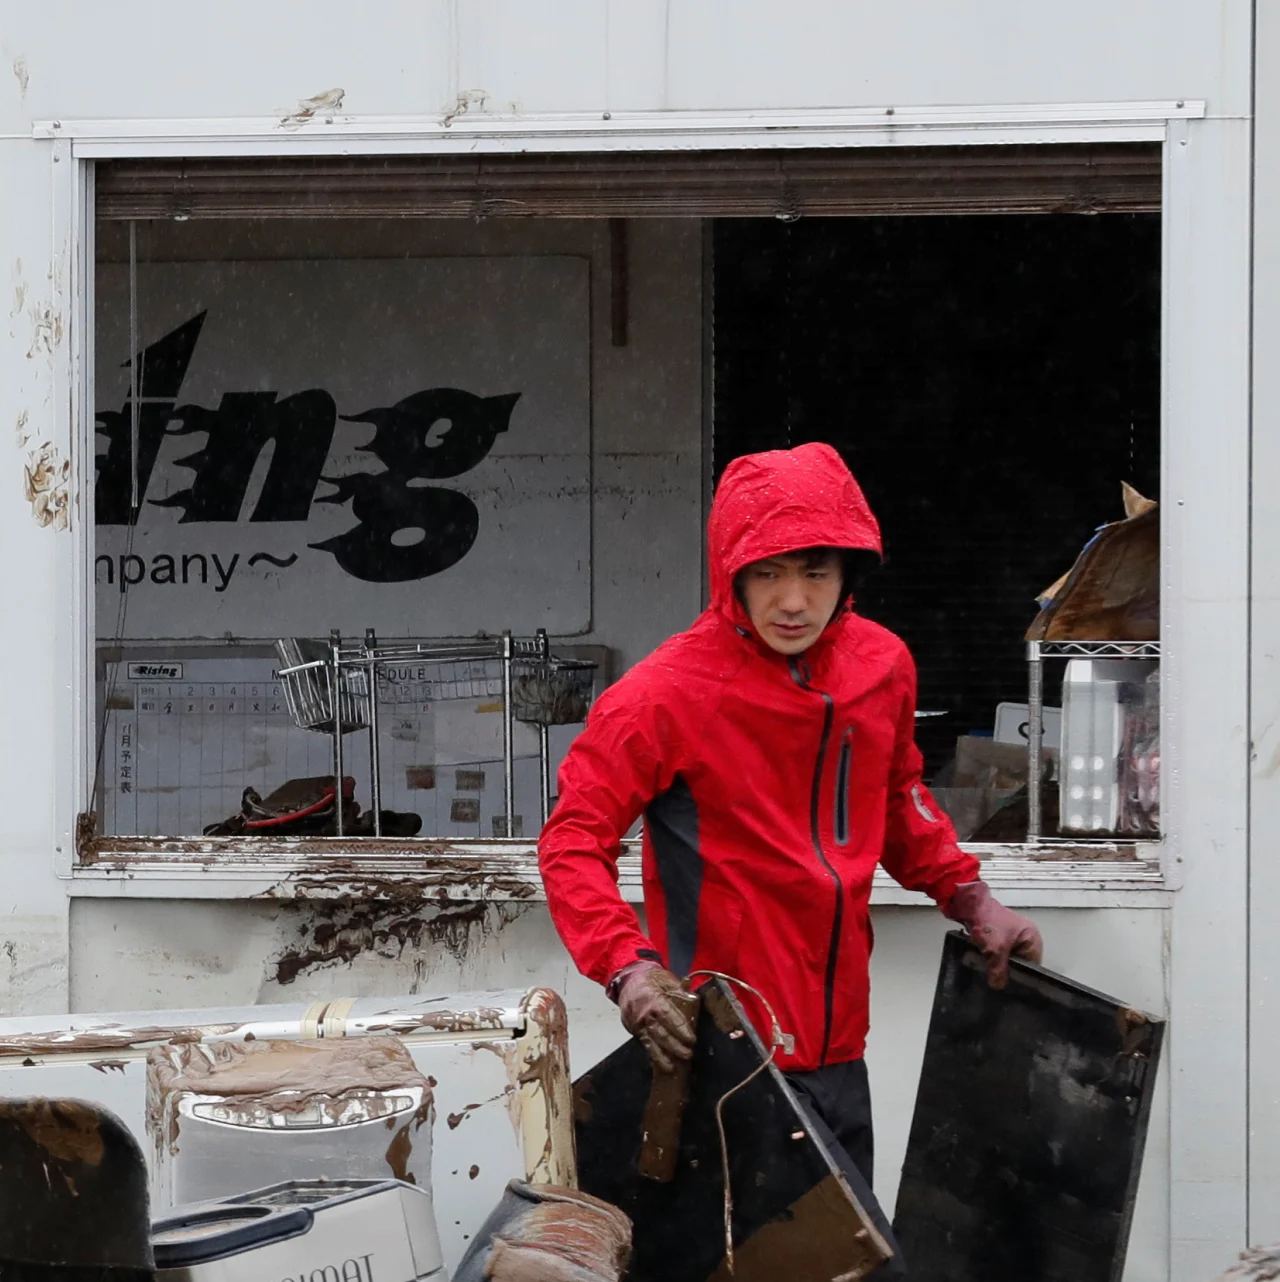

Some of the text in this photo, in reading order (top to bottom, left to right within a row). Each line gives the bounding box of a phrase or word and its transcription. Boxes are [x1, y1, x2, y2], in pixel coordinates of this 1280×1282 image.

[95, 552, 298, 592] mpany~
[133, 665, 178, 677] Rising
[378, 667, 426, 680] EDULE
[187, 686, 194, 696] 2
[209, 686, 216, 696] 3
[230, 687, 236, 696] 4
[252, 687, 258, 696] 5
[273, 686, 280, 696] 6
[400, 686, 410, 696] 12
